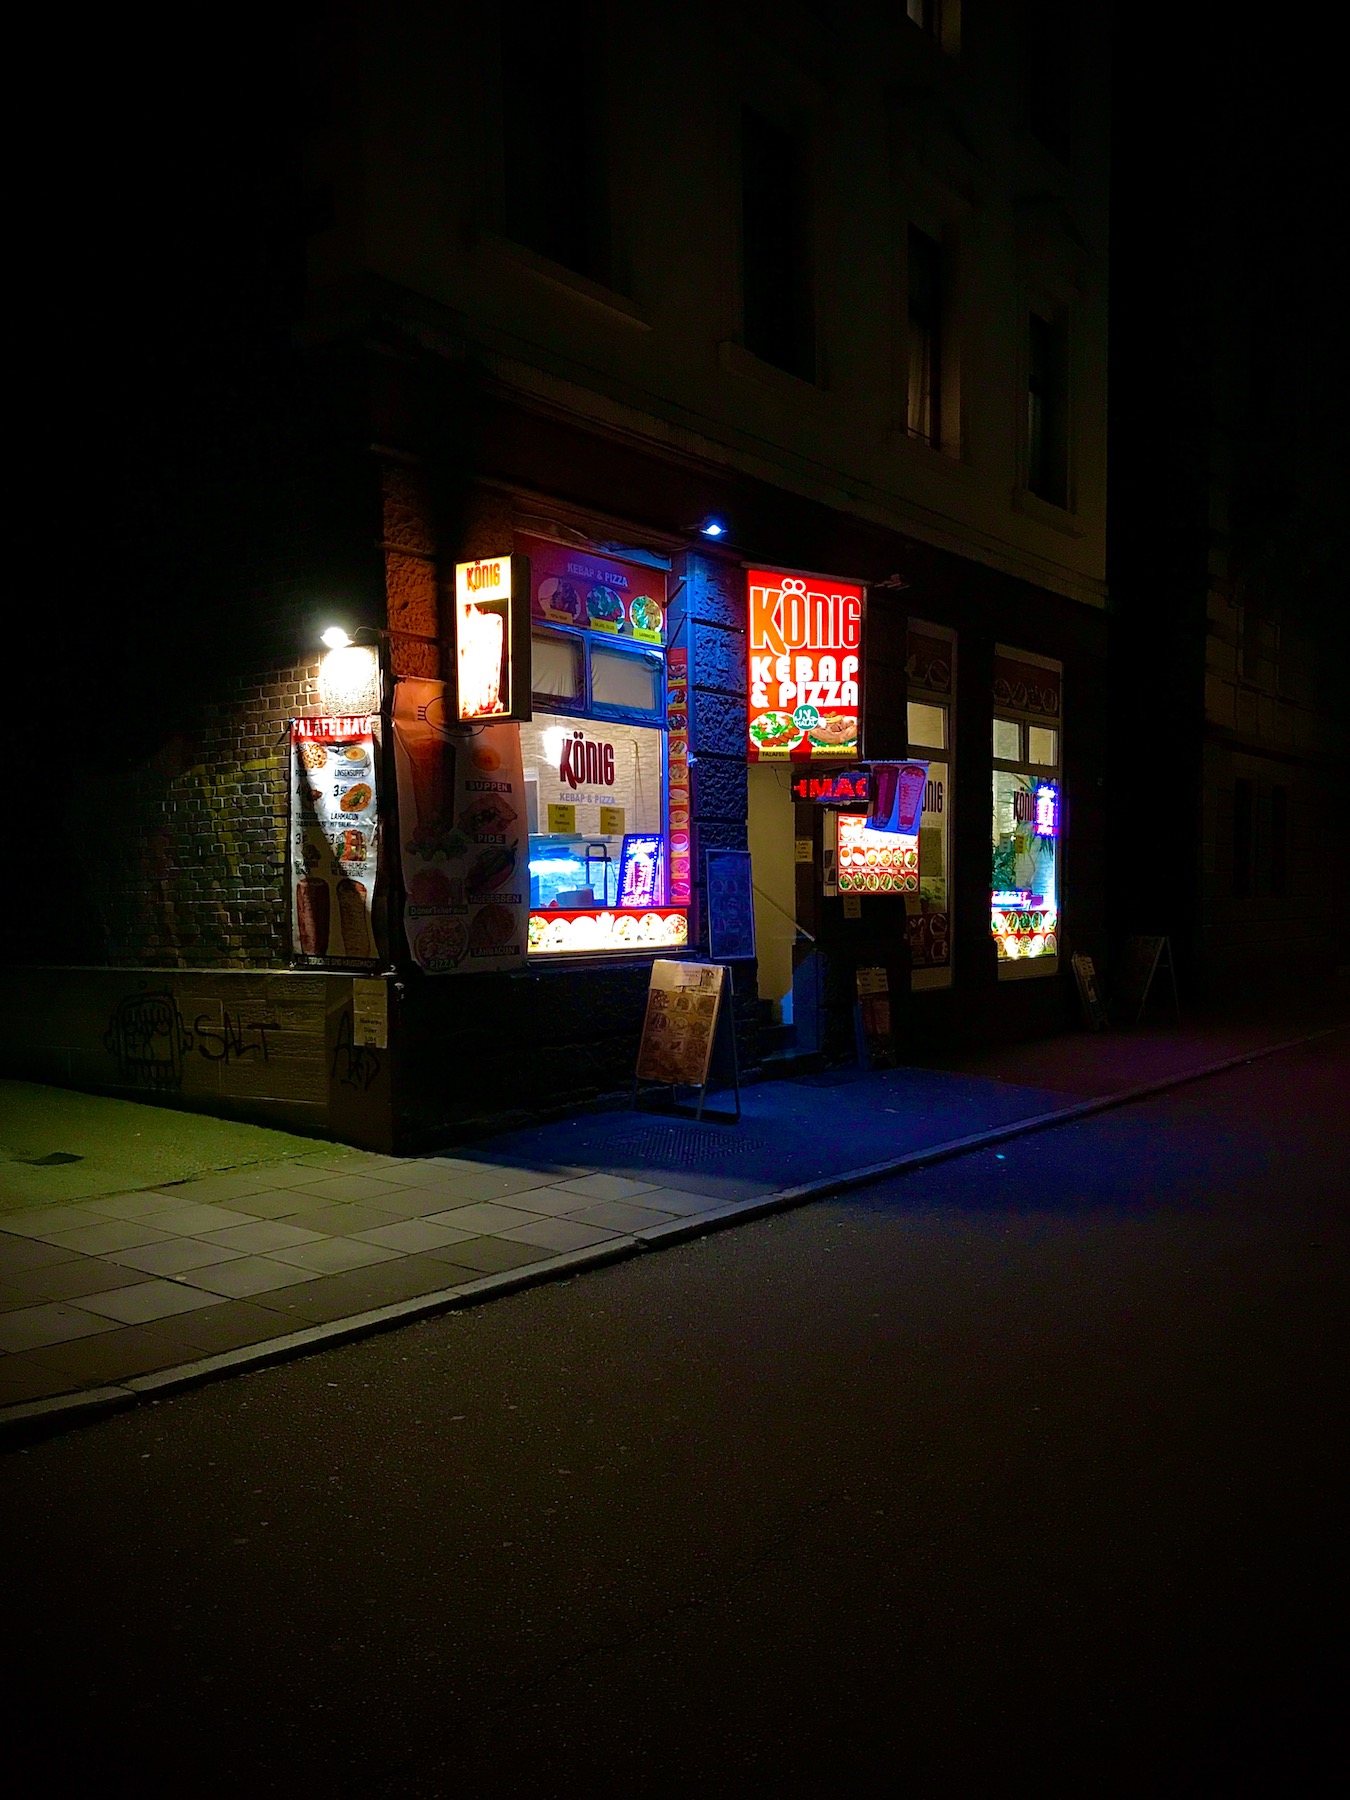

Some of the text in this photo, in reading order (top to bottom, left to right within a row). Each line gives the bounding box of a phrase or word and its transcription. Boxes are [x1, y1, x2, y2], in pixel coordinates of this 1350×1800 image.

[466, 560, 501, 592] KÖNIG
[567, 562, 628, 587] KEBAP & PIZZA
[750, 578, 861, 657] KÖNIG
[751, 655, 859, 683] KEBAP
[751, 681, 859, 708] & PIZZA
[559, 731, 615, 790] KÖNIG
[334, 769, 365, 777] LINSENSUPPE
[469, 781, 508, 791] SUPPEN
[595, 796, 616, 805] PIZZA
[477, 834, 504, 843] PIDE
[469, 894, 520, 903] TAGESESSEN
[473, 947, 515, 956] LAHMACUN
[429, 960, 455, 969] PIZZA
